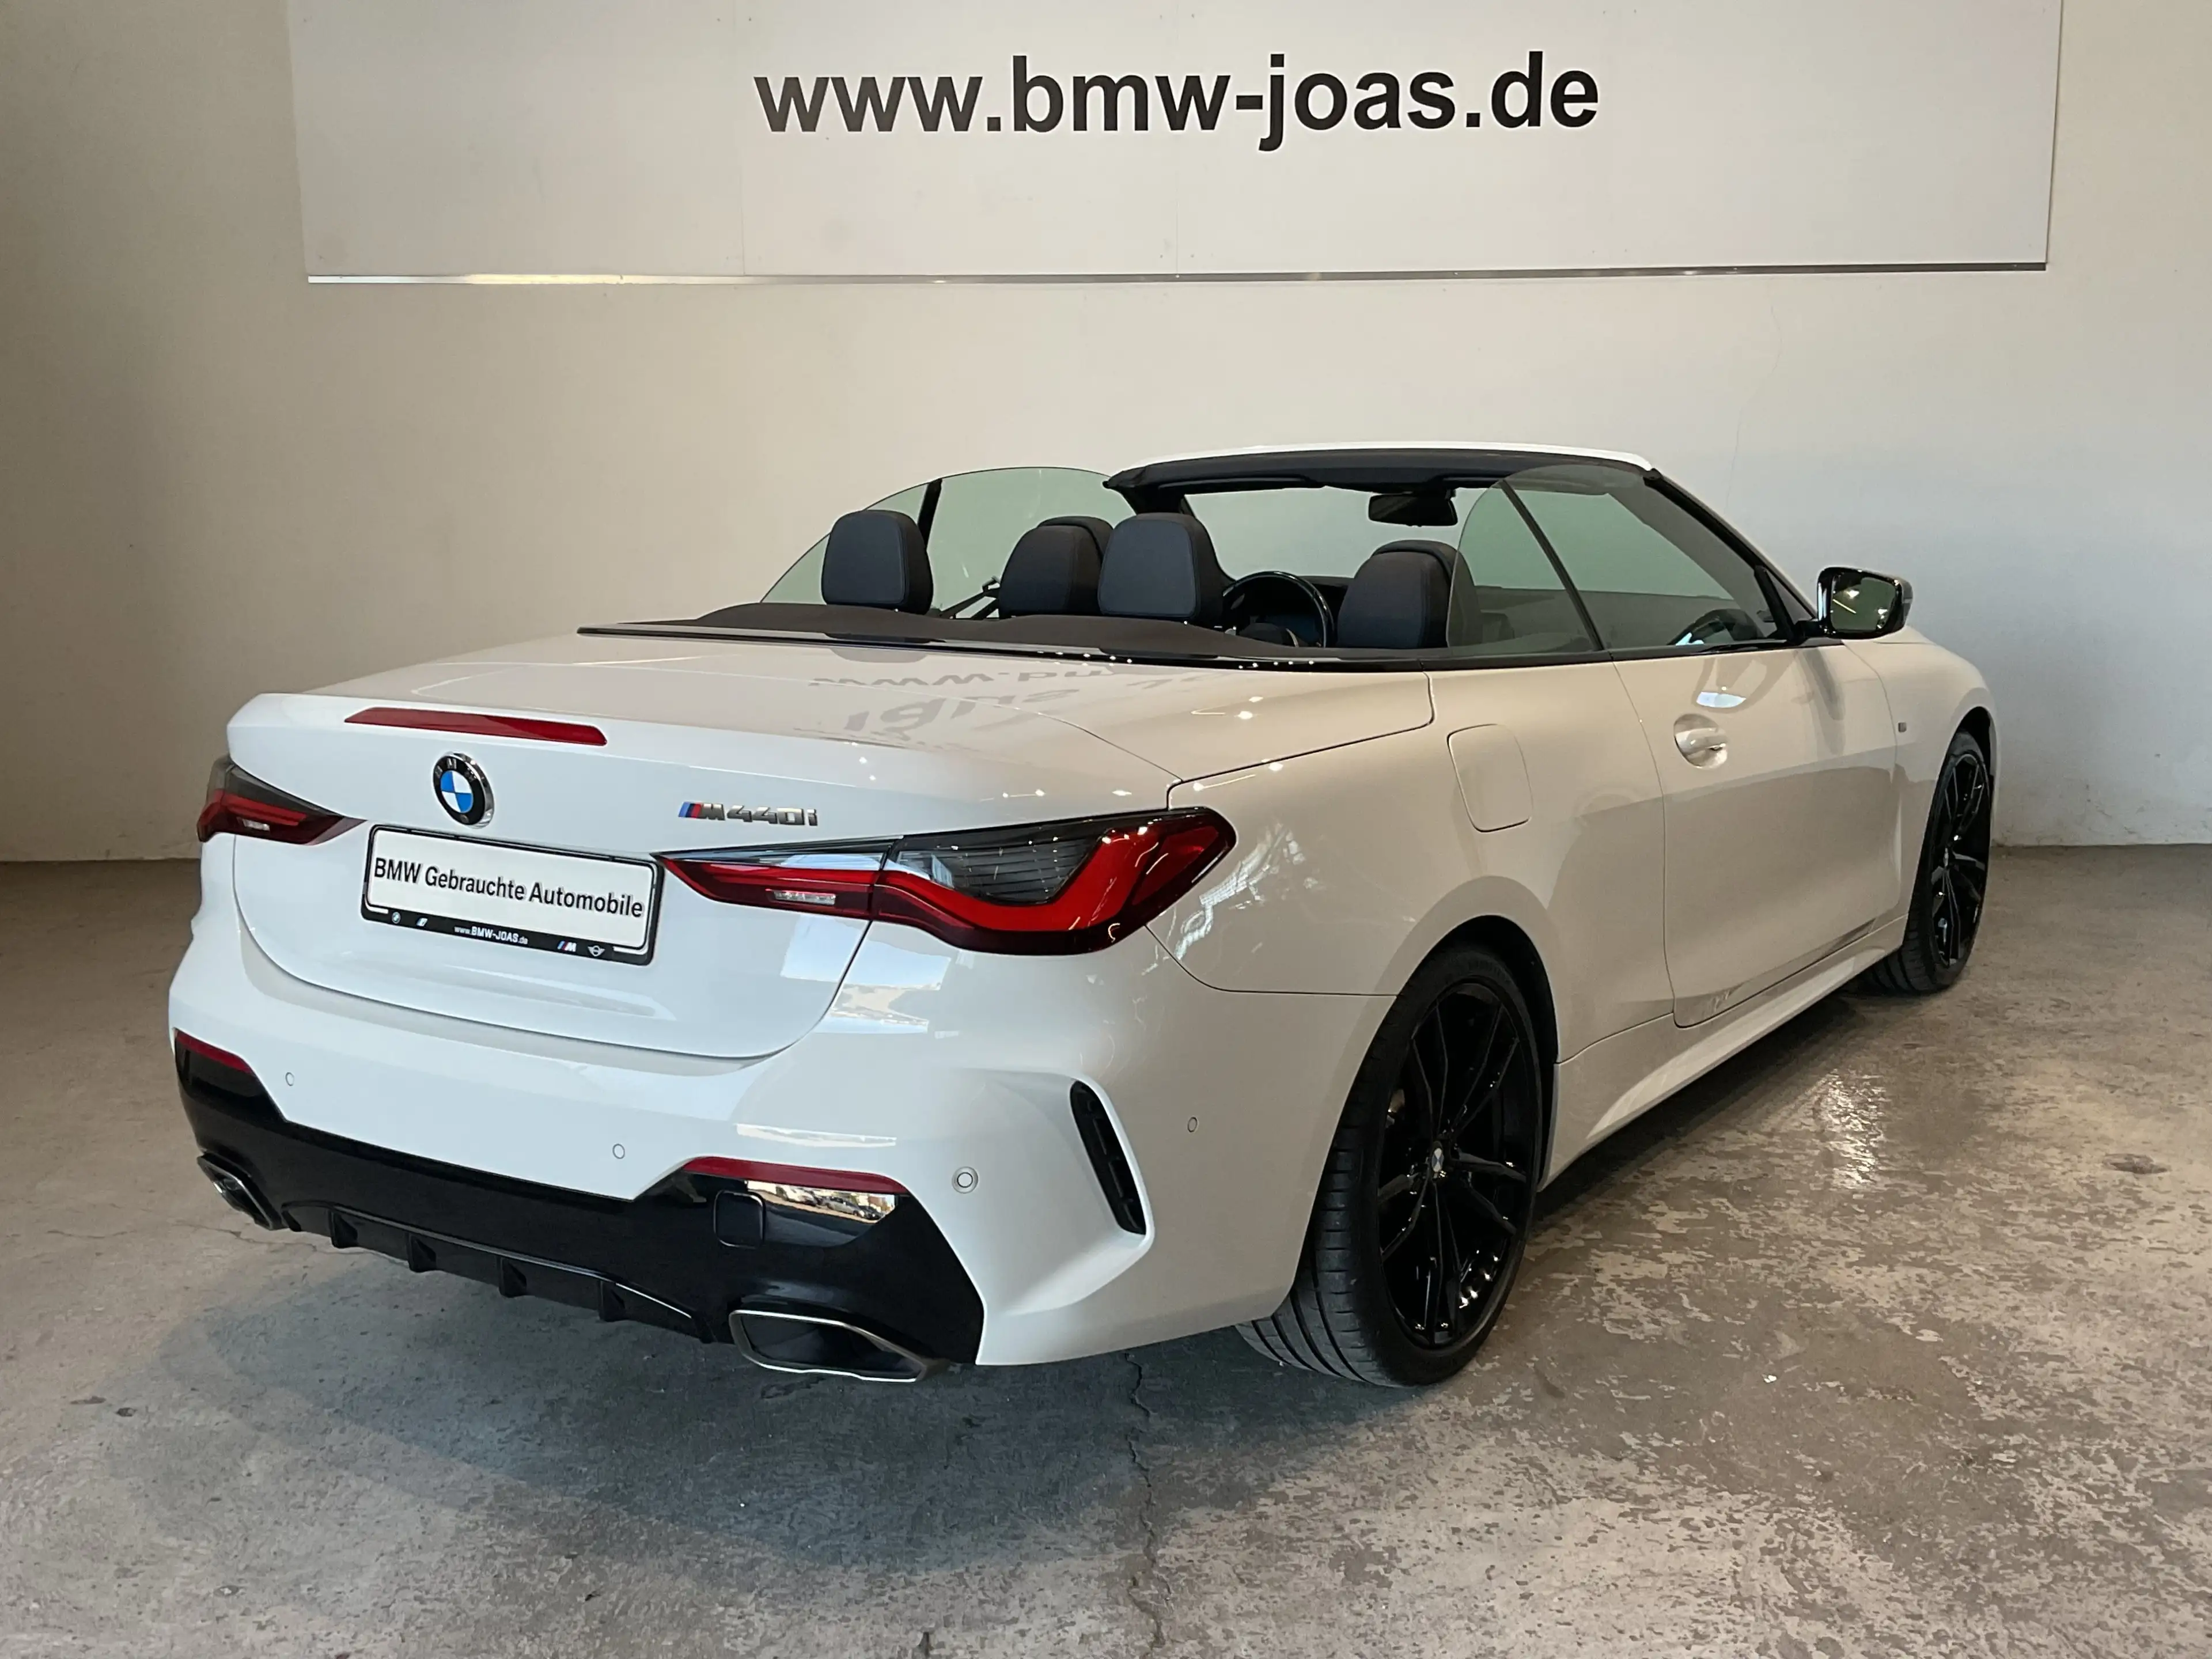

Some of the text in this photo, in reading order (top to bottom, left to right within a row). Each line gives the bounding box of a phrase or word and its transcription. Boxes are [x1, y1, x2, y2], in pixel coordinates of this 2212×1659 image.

[753, 51, 1599, 151] www.bmw-joas.de
[699, 802, 818, 827] M440i
[374, 857, 643, 918] BMW Gebrauchte Automobile
[454, 926, 528, 945] www.BMW-JOAS.de
